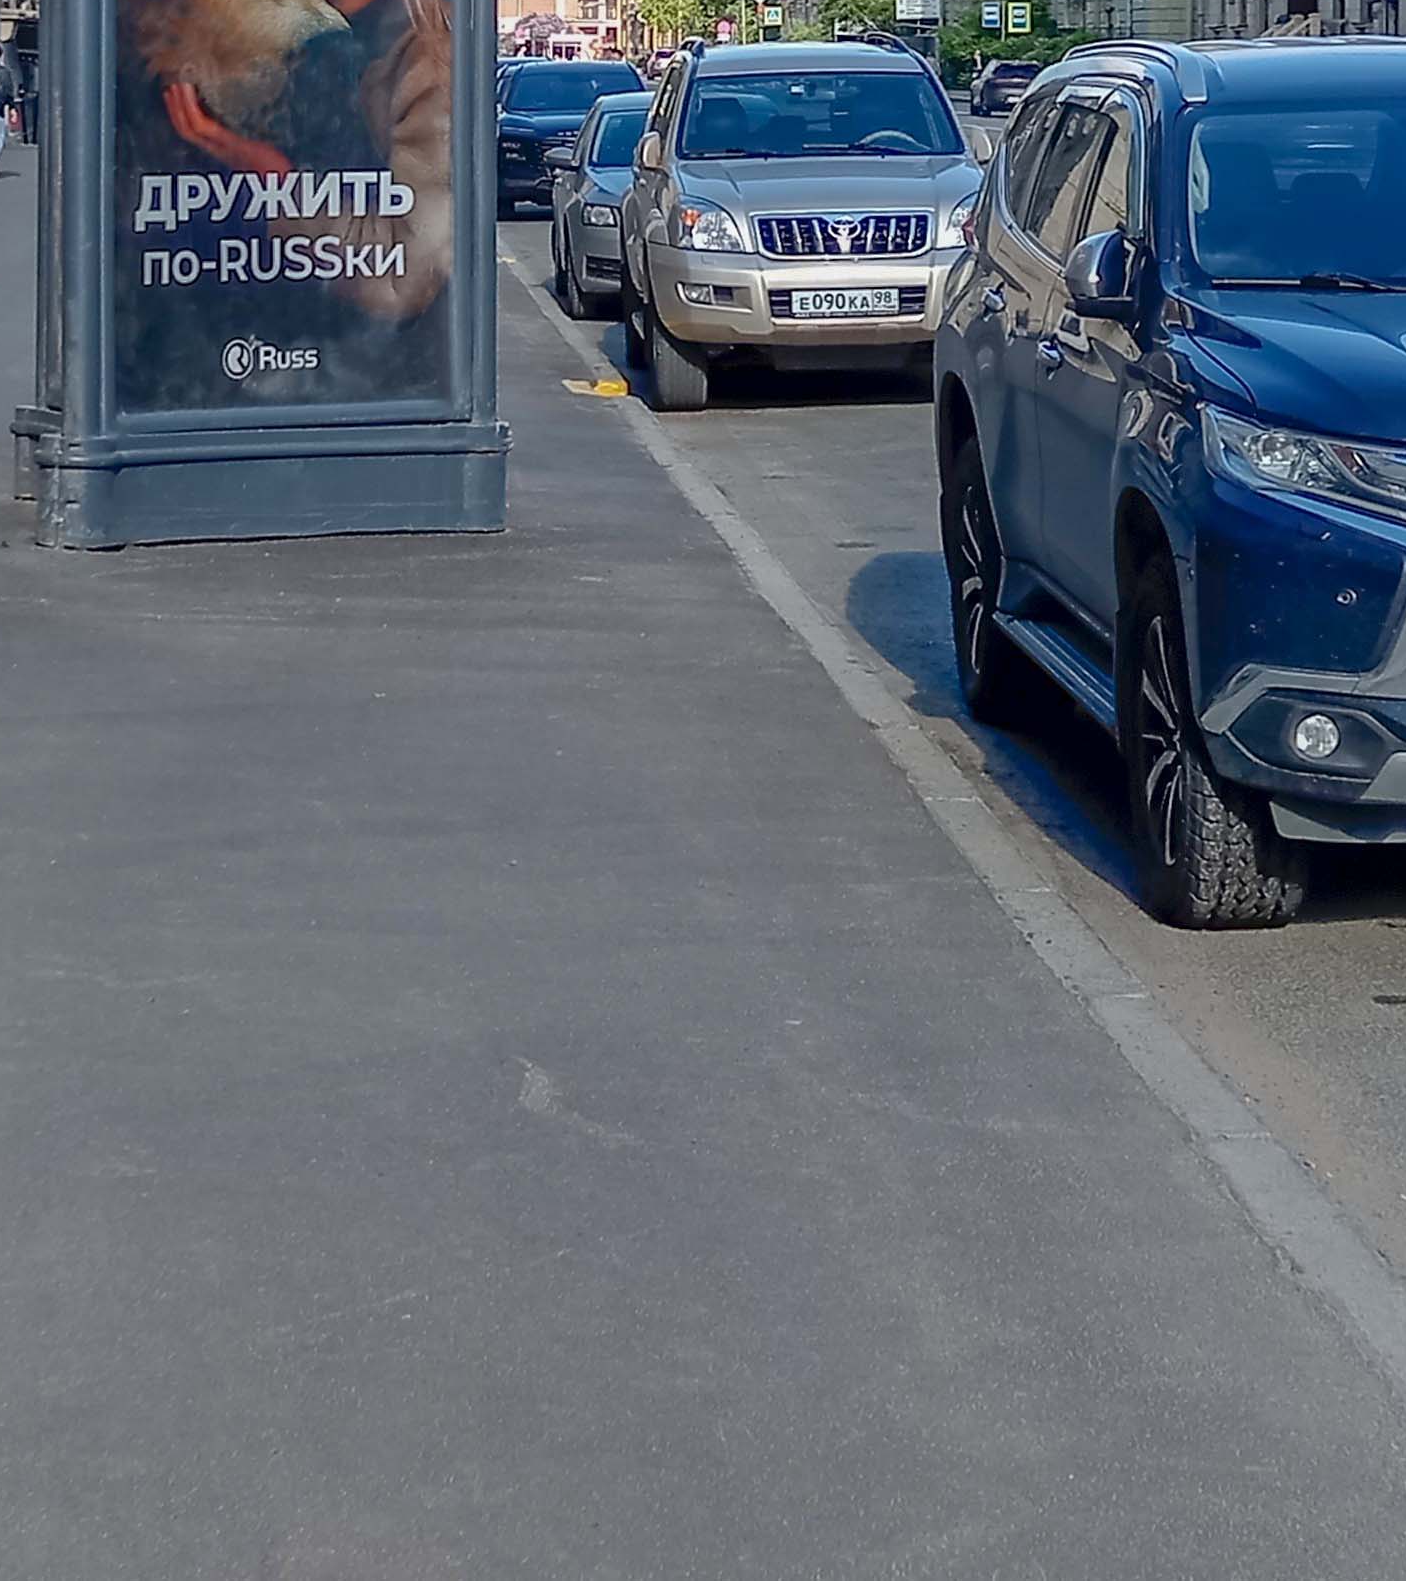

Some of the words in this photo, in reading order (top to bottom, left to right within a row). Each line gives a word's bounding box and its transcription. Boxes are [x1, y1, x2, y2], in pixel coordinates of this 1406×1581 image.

[134, 171, 415, 232] ДРУЖИТЬ
[873, 290, 893, 304] 98
[258, 345, 319, 370] Russ
